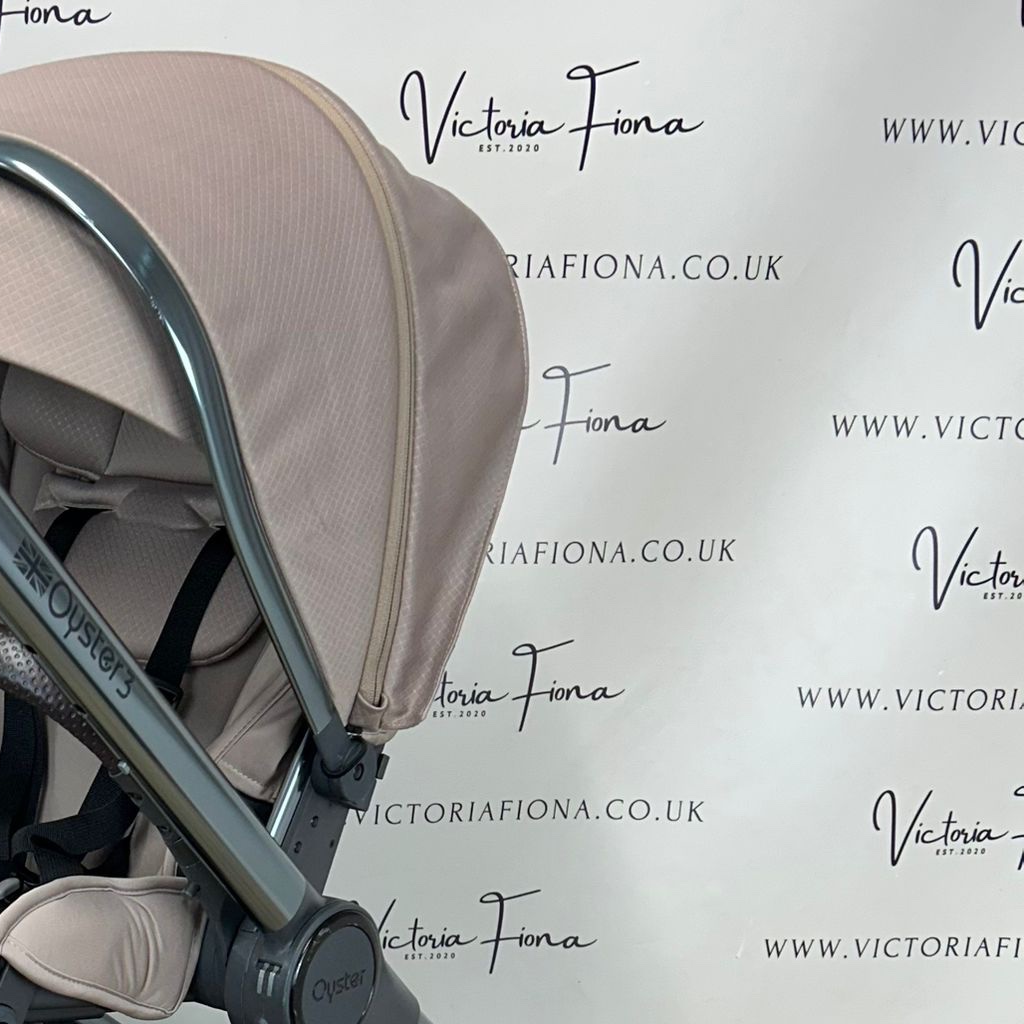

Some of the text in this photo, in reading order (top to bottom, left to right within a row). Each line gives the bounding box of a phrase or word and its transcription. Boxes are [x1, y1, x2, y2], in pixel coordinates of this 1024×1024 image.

[400, 60, 704, 171] Victoria Fiona
[479, 144, 539, 152] EST.2020
[542, 363, 667, 465] Fiona
[511, 639, 625, 732] Fiona
[433, 710, 486, 718] EST.2020
[872, 790, 1009, 867] Victoria
[935, 848, 986, 856] EST.2020
[404, 952, 455, 960] EST.2020
[479, 889, 597, 974] Fiona
[312, 969, 366, 1003] Oyster
